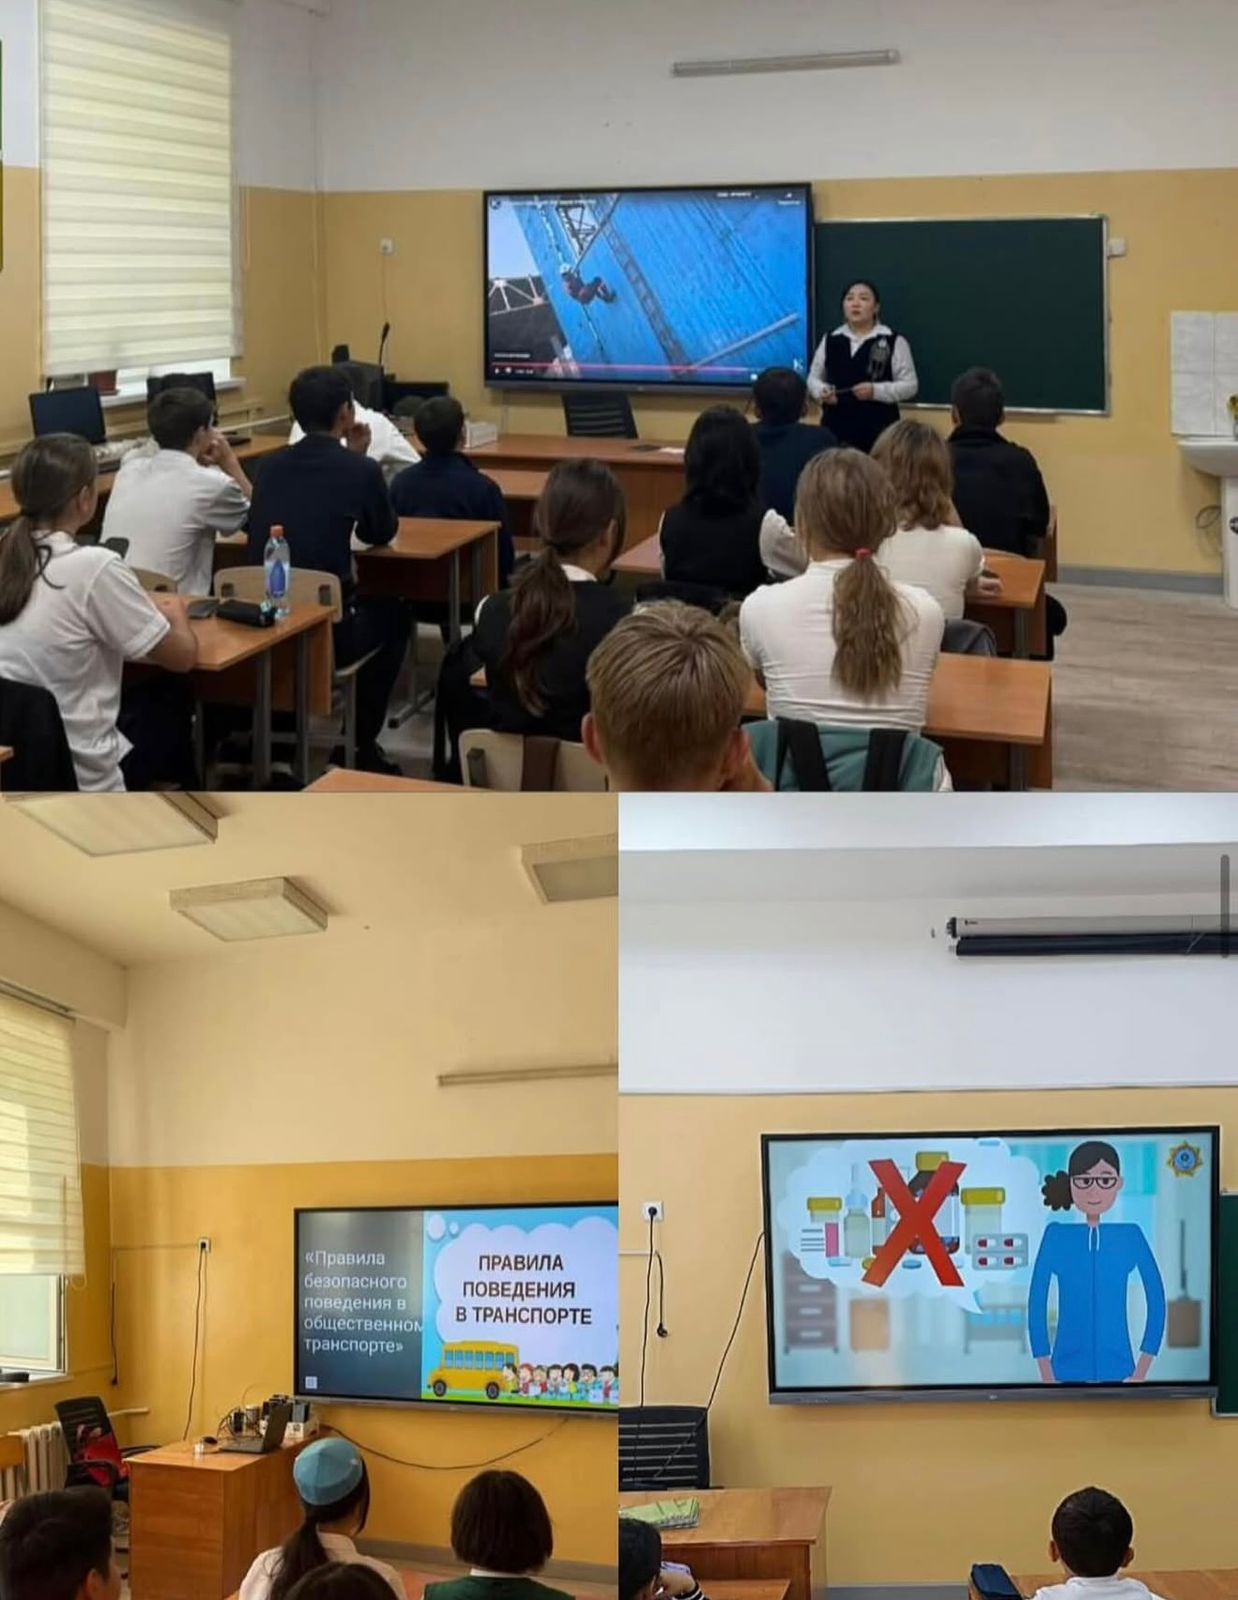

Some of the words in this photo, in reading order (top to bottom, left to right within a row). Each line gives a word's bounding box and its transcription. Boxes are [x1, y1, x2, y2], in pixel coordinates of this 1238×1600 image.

[305, 1250, 385, 1268] «Правила
[479, 1254, 564, 1271] ПРАВИЛА
[304, 1272, 407, 1288] безопасного
[463, 1281, 575, 1302] ПОВЕДЕНИЯ
[304, 1297, 391, 1312] поведения
[397, 1299, 406, 1310] в
[456, 1306, 467, 1322] В
[472, 1306, 592, 1325] ТРАНСПОРТЕ
[304, 1338, 403, 1357] транспорте»
